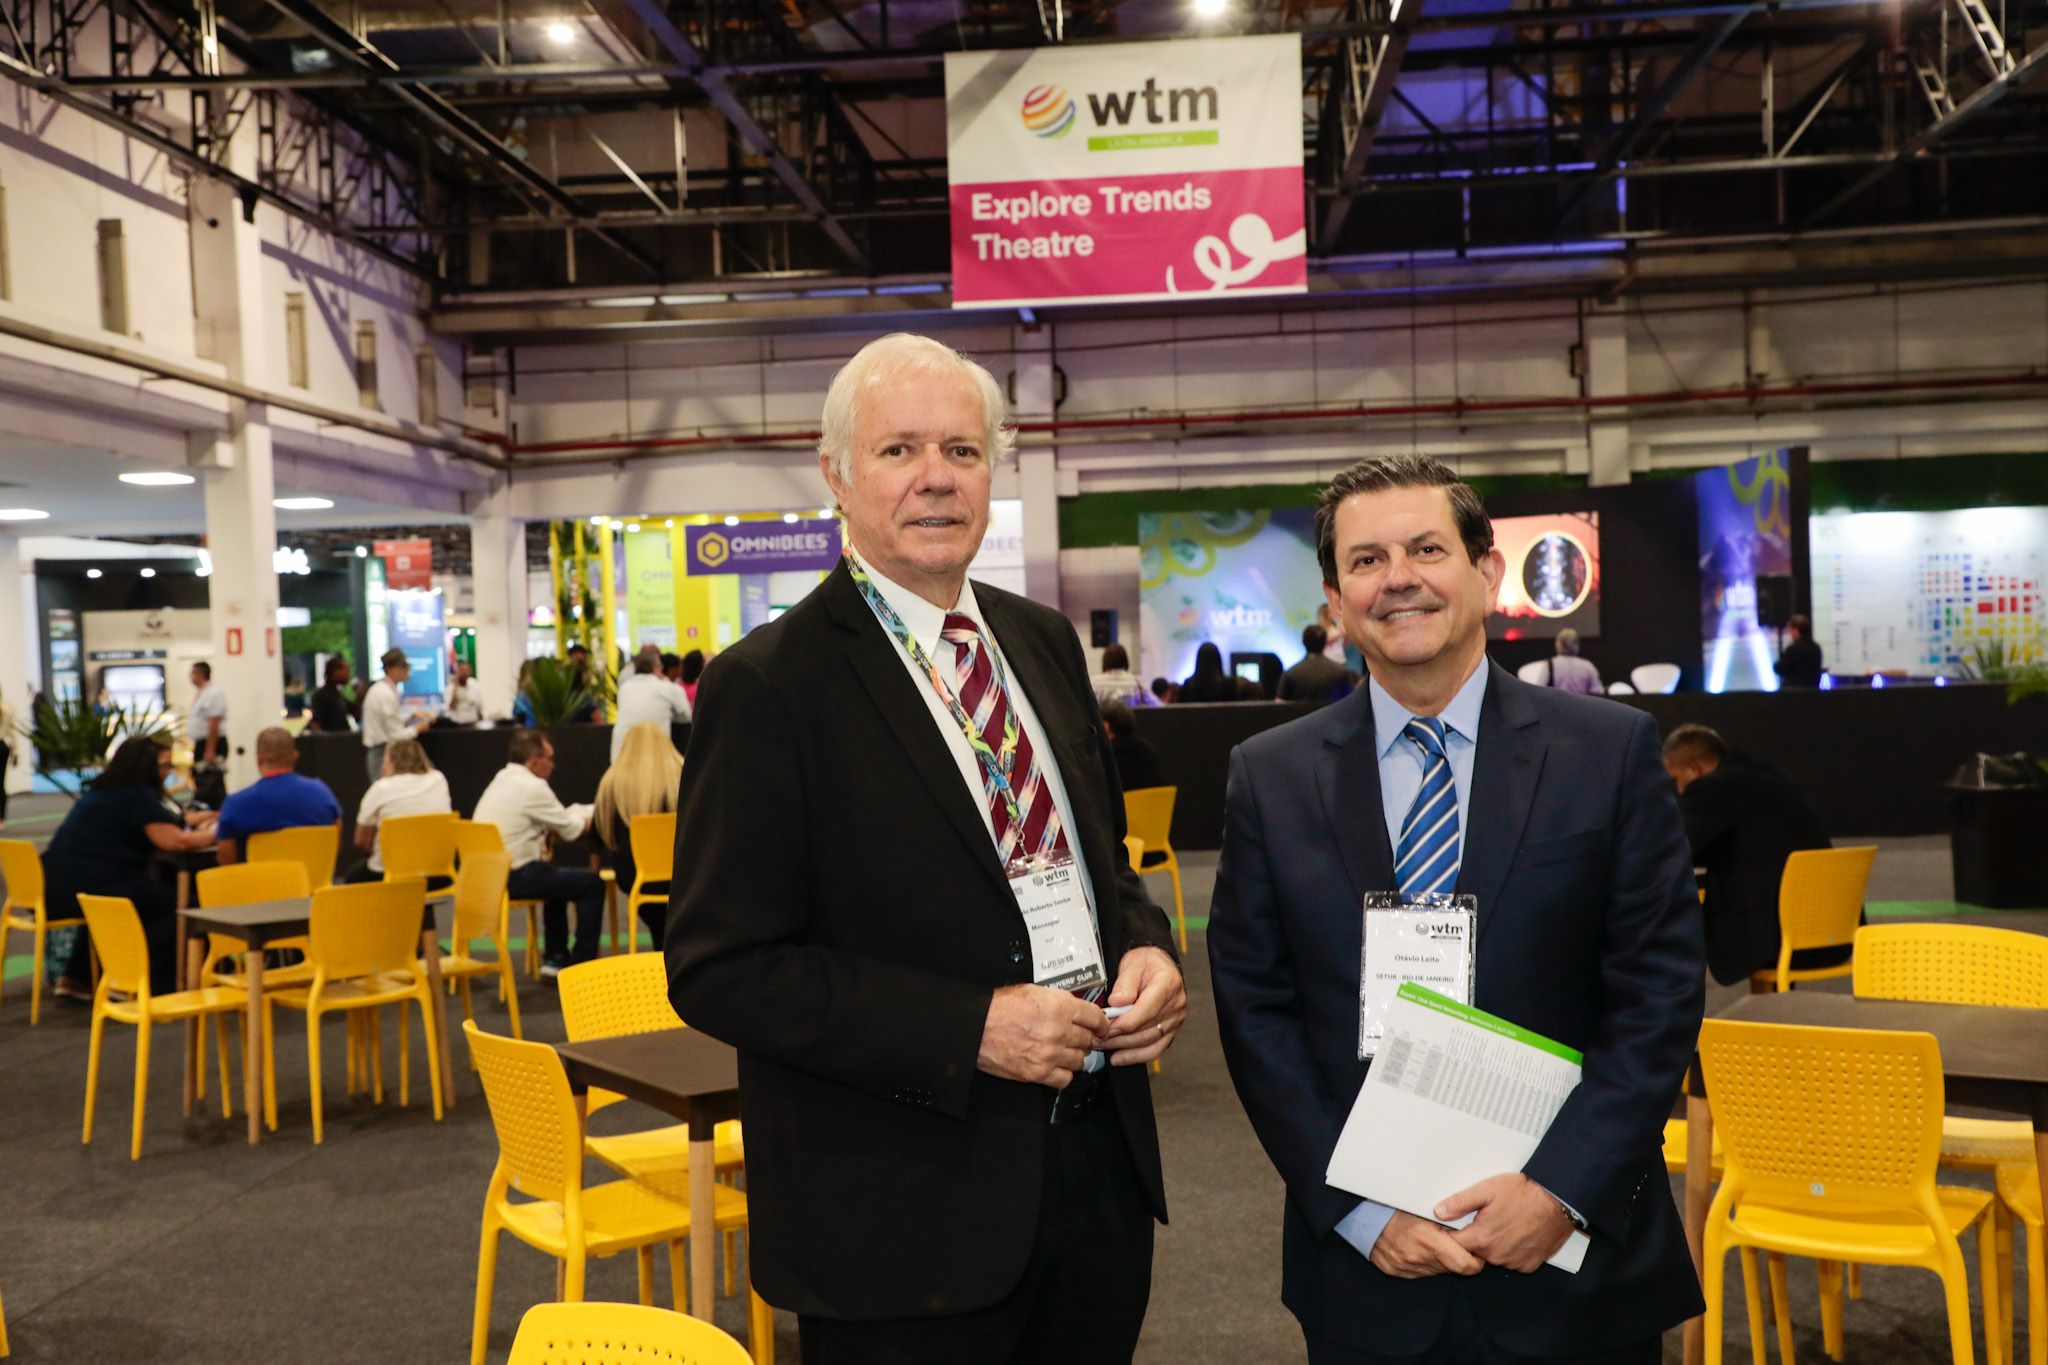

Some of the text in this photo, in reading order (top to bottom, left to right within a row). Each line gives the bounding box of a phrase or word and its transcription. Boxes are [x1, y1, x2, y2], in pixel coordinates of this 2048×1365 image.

[1087, 77, 1218, 127] wtm
[971, 182, 1212, 225] Explore Trends
[972, 231, 1095, 261] Theatre
[730, 532, 829, 553] OMNIBEES
[1209, 604, 1272, 630] wtm
[1044, 869, 1069, 882] wtm
[1431, 923, 1463, 934] wtm
[1394, 954, 1440, 963] Otávio Leite
